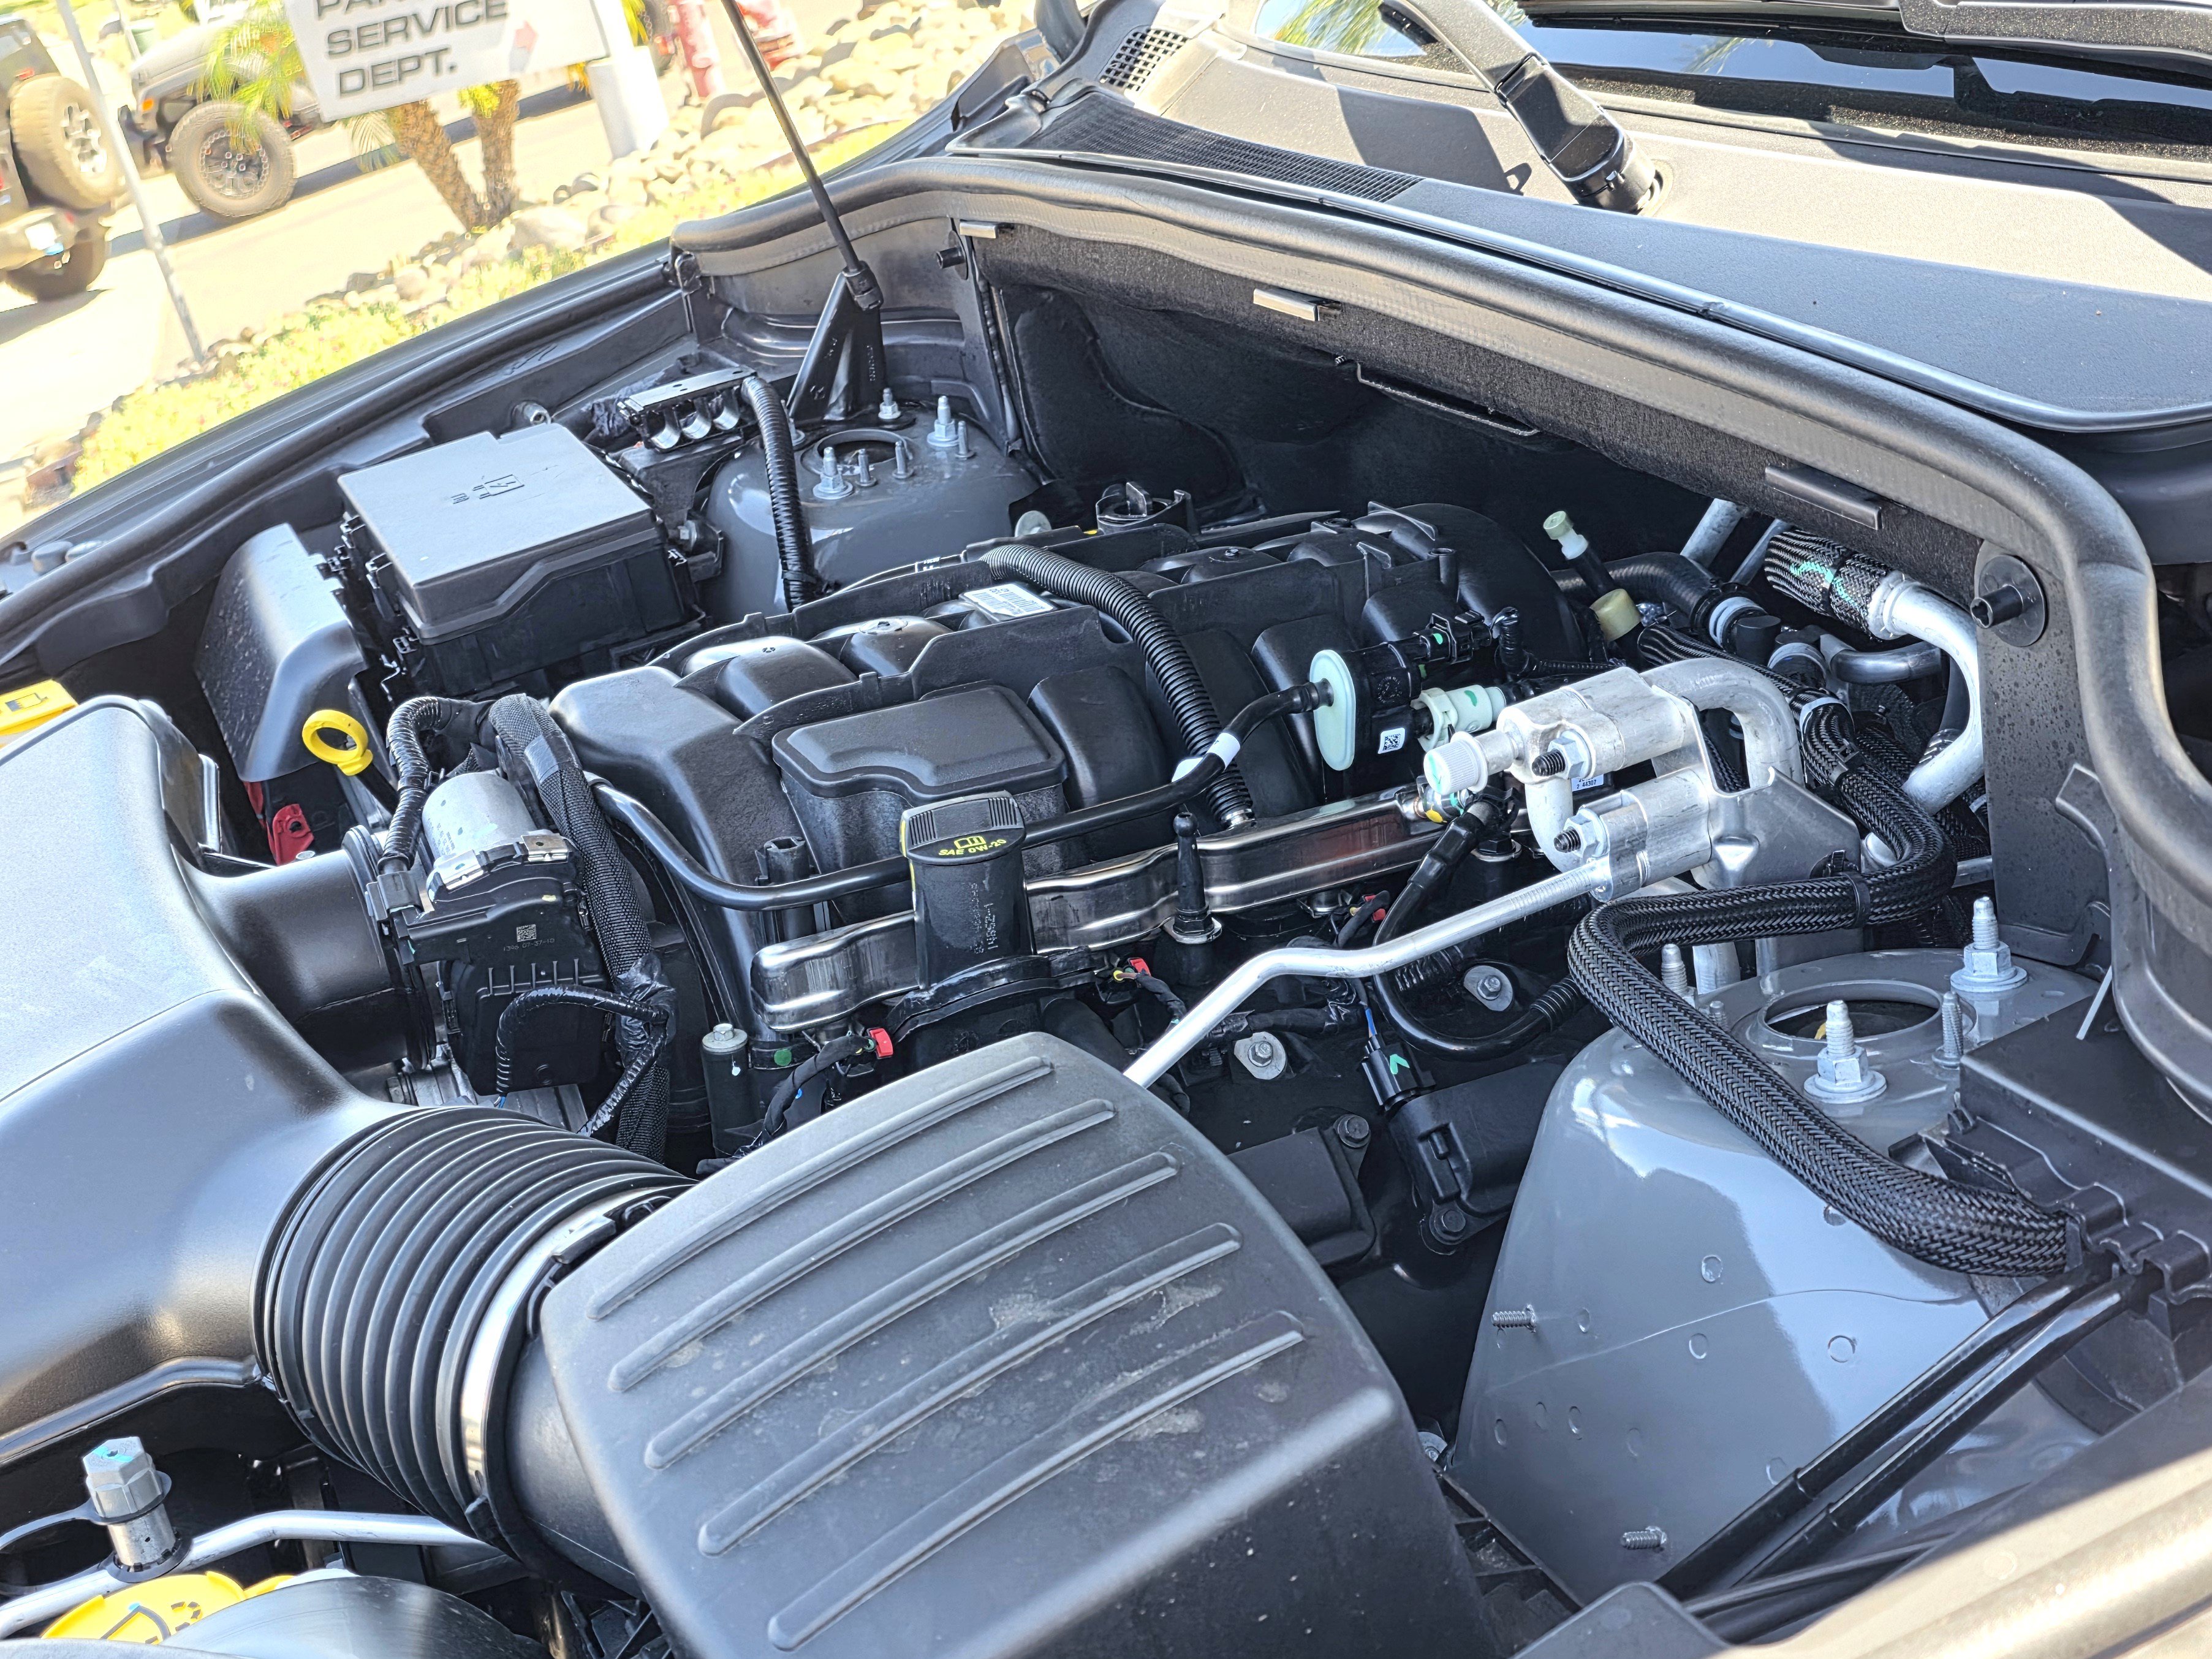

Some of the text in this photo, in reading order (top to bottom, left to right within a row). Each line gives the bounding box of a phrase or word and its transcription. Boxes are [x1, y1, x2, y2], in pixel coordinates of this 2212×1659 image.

[316, 0, 386, 18] PA
[327, 0, 507, 56] SERVICE
[338, 45, 456, 96] DEPT.
[968, 839, 1007, 853] 0W-20
